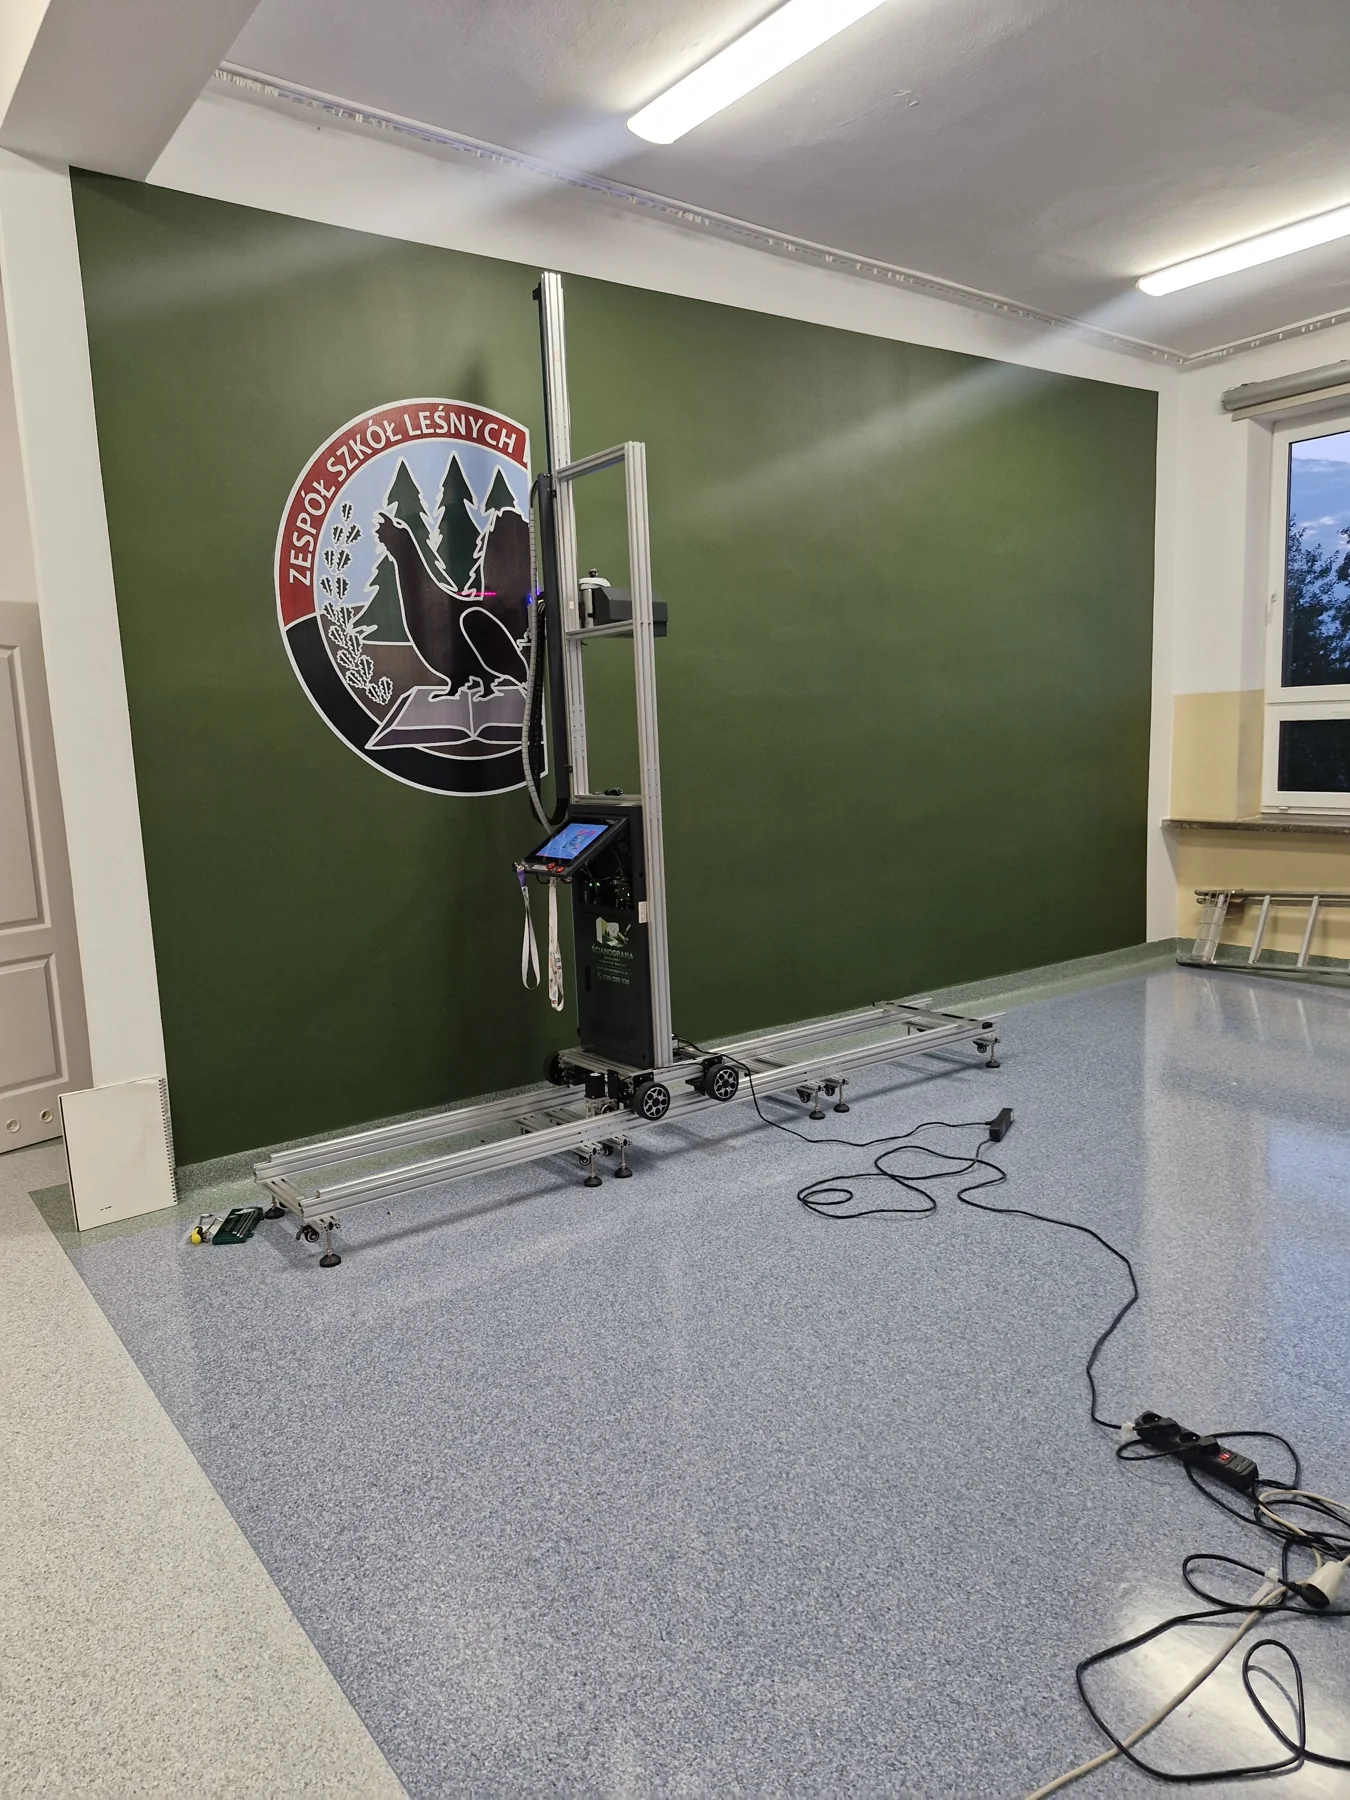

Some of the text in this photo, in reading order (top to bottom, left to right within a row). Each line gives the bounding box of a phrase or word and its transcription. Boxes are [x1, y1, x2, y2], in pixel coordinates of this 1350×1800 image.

[289, 478, 336, 587] ZESPÓŁ
[326, 419, 403, 483] SZKÓŁ
[403, 405, 517, 454] LEŚNYCH
